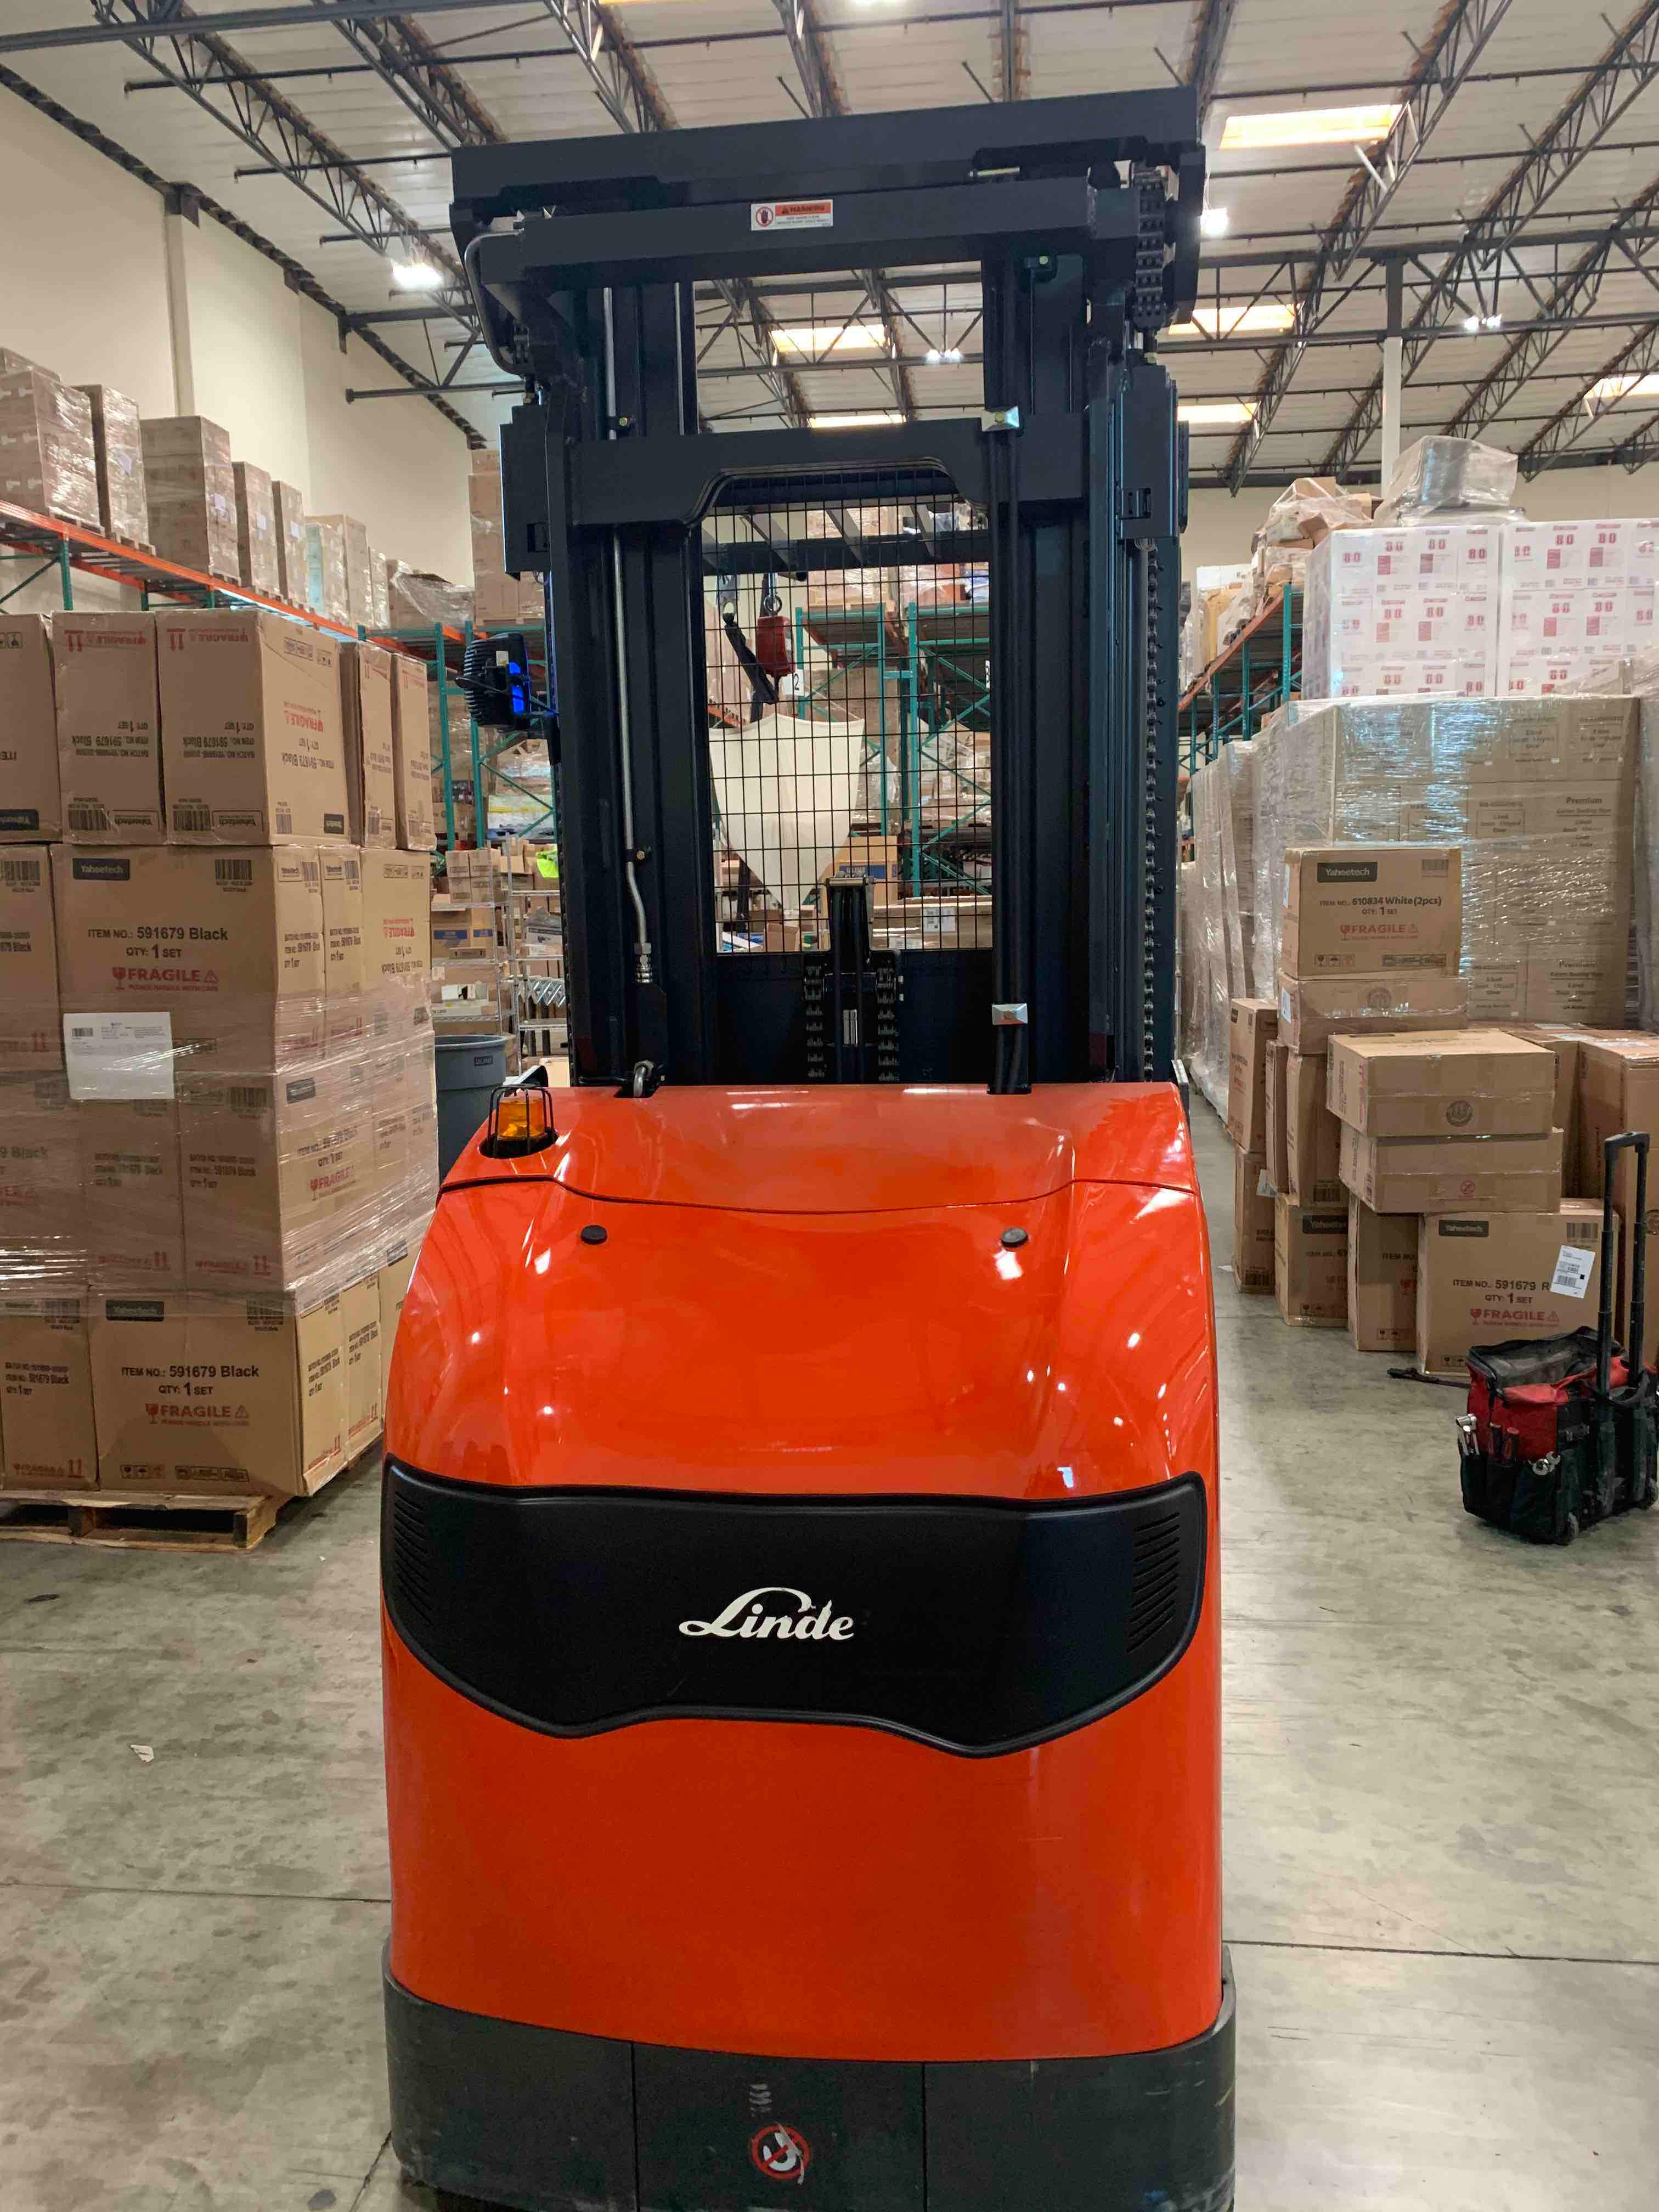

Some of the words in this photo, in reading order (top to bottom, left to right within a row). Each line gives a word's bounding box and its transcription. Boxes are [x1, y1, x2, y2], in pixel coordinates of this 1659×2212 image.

[81, 865, 123, 874] Yaheetech
[1325, 867, 1370, 877] Yaheetech
[1352, 897, 1383, 906] 610834
[1379, 906, 1385, 915] 1
[88, 929, 111, 939] ITEM
[137, 927, 185, 940] 591679
[189, 927, 229, 941] Black
[1351, 924, 1406, 933] FRAGILE
[126, 947, 149, 957] QTY:
[151, 944, 160, 958] 1
[162, 948, 182, 958] SET
[128, 968, 201, 982] FRAGILE
[318, 1166, 351, 1189] FRAGILE
[1453, 1279, 1473, 1287] ITEM
[1495, 1279, 1537, 1291] 591679
[1508, 1293, 1514, 1304] 1
[1516, 1296, 1533, 1304] SET
[1483, 1309, 1545, 1321] FRAGILE
[121, 1367, 143, 1376] ITEM
[169, 1365, 217, 1378] 591679
[221, 1365, 259, 1378] Black
[158, 1385, 180, 1395] QTY:
[183, 1381, 191, 1396] 1
[193, 1386, 214, 1396] SET
[160, 1404, 232, 1418] FRAGILE
[679, 1587, 854, 1640] Linde
